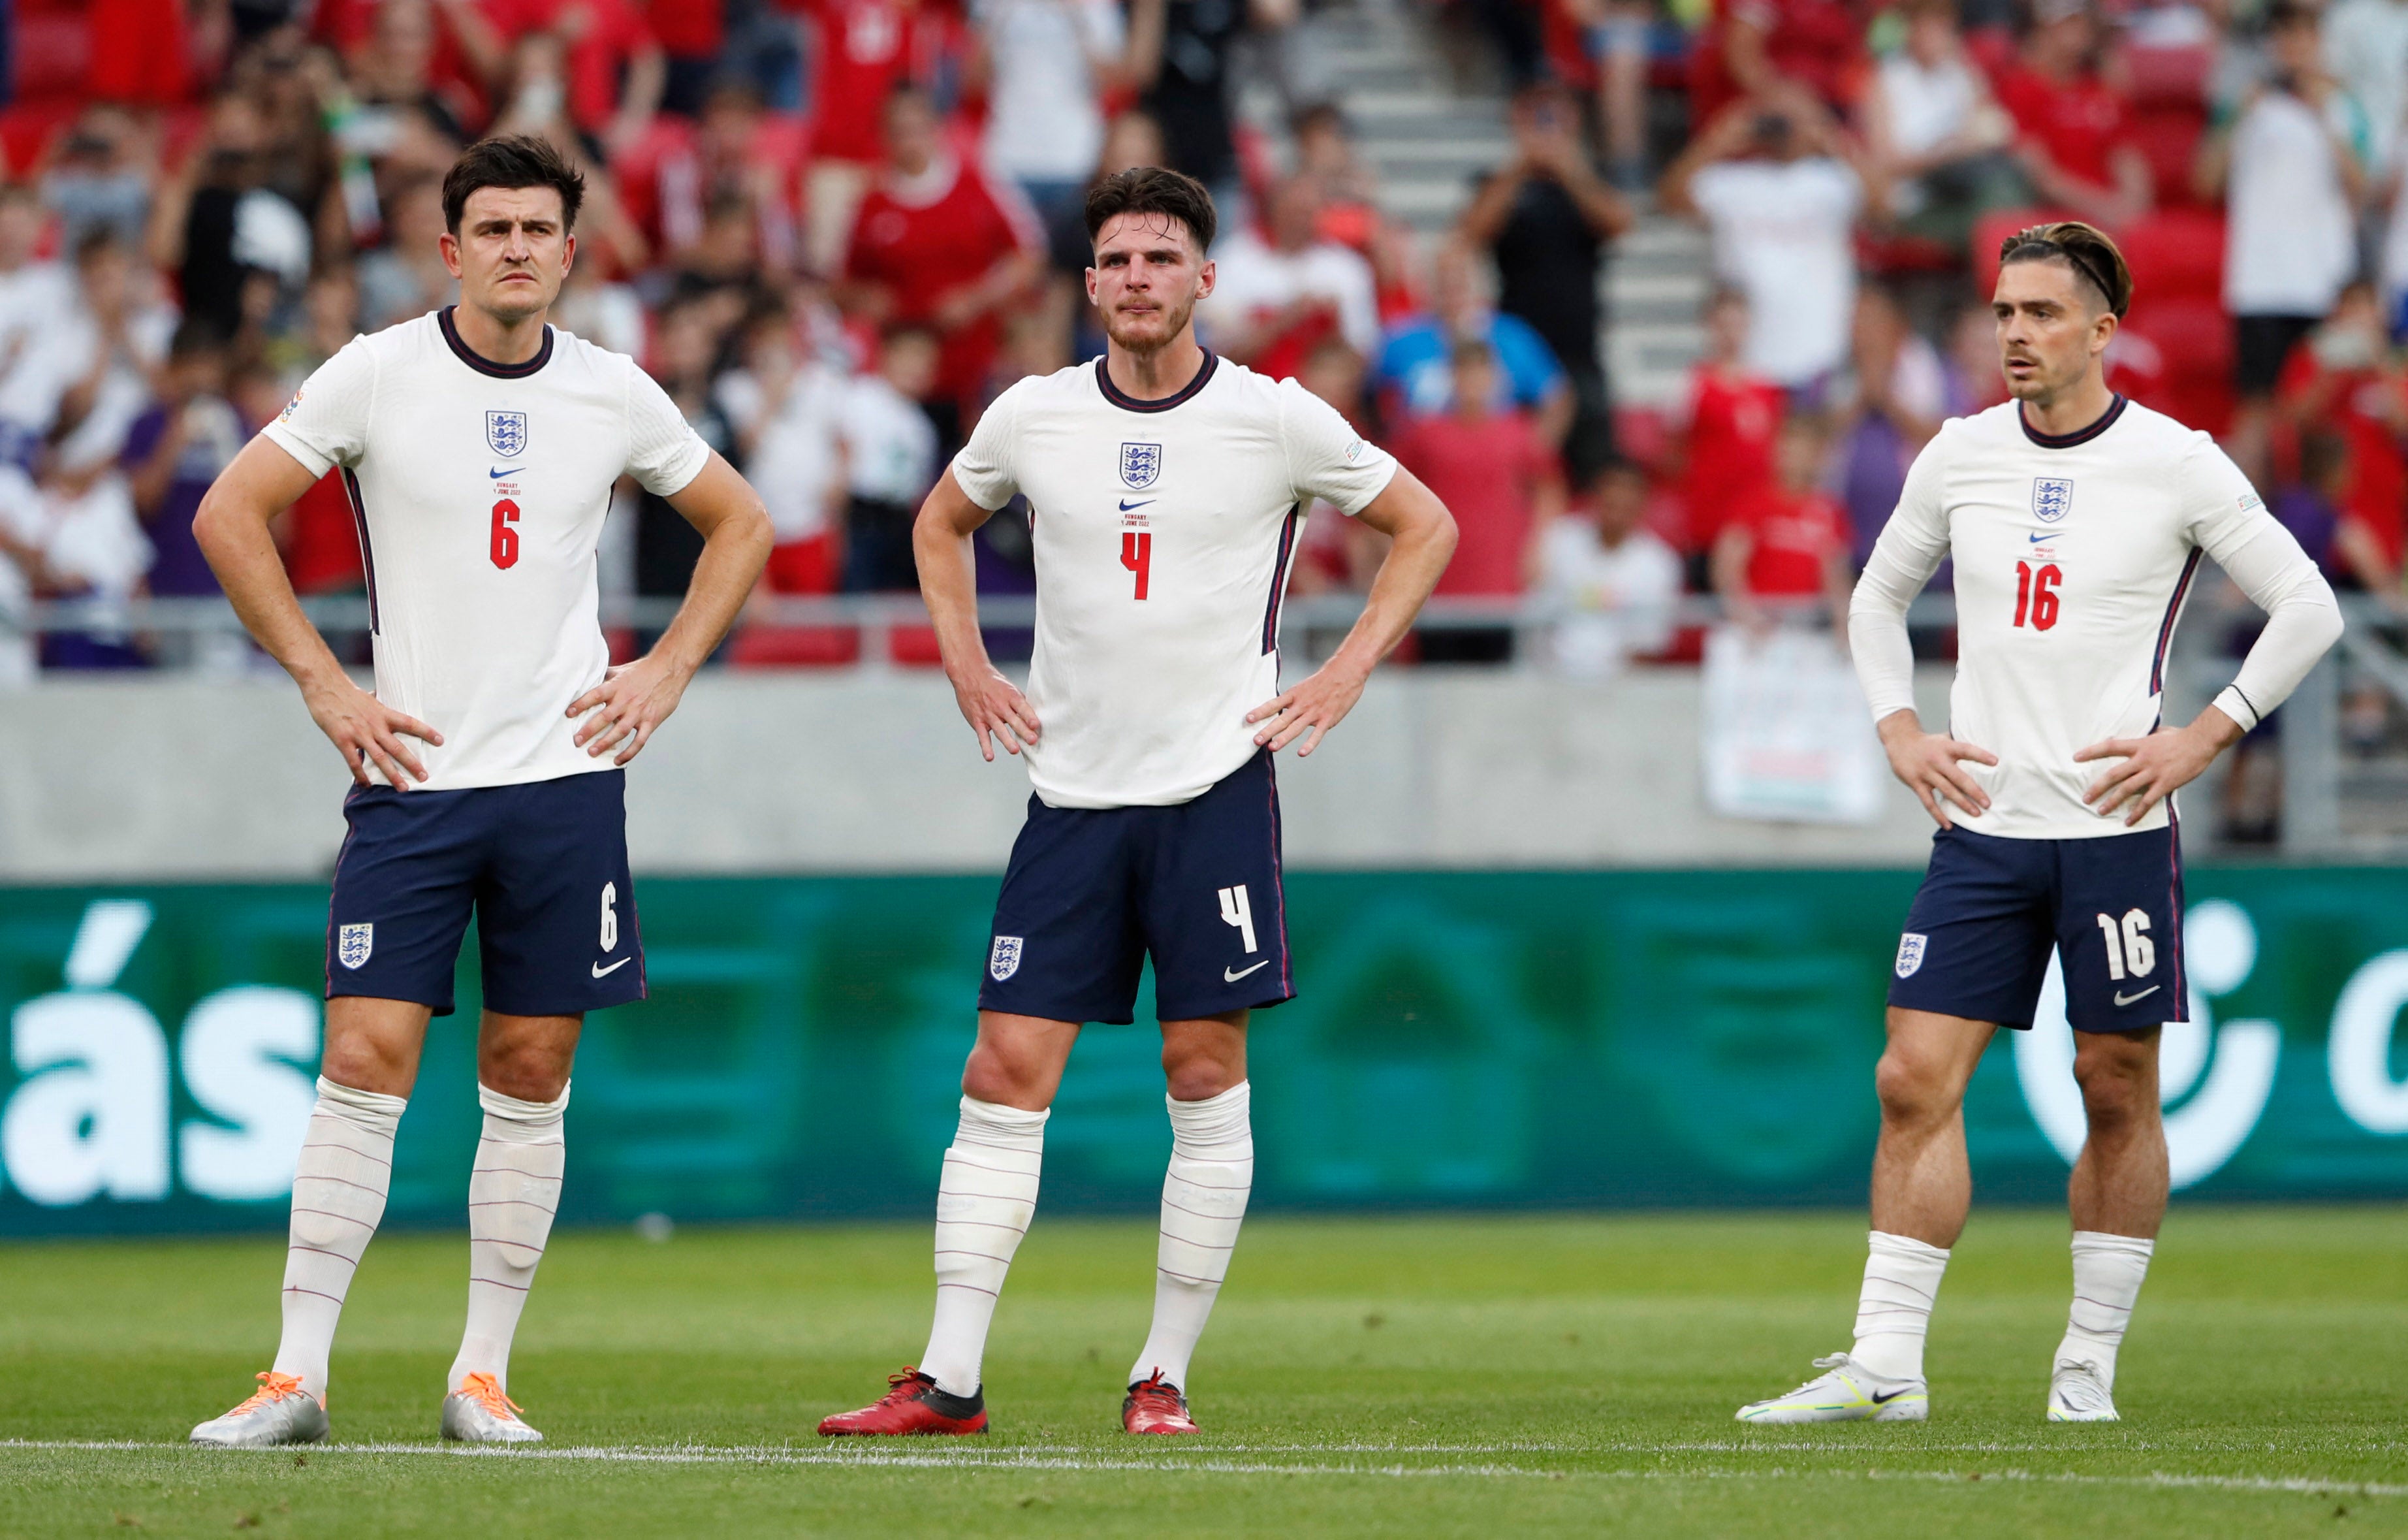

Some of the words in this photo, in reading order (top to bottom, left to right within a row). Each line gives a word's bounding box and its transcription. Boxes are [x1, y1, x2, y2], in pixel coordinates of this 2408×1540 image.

[490, 498, 520, 570] 6
[1120, 532, 1151, 600] 4
[2014, 560, 2062, 632] 16
[600, 881, 618, 953] 6
[1218, 884, 1258, 954] 4
[2097, 908, 2156, 980] 16
[1, 899, 323, 1208] ás
